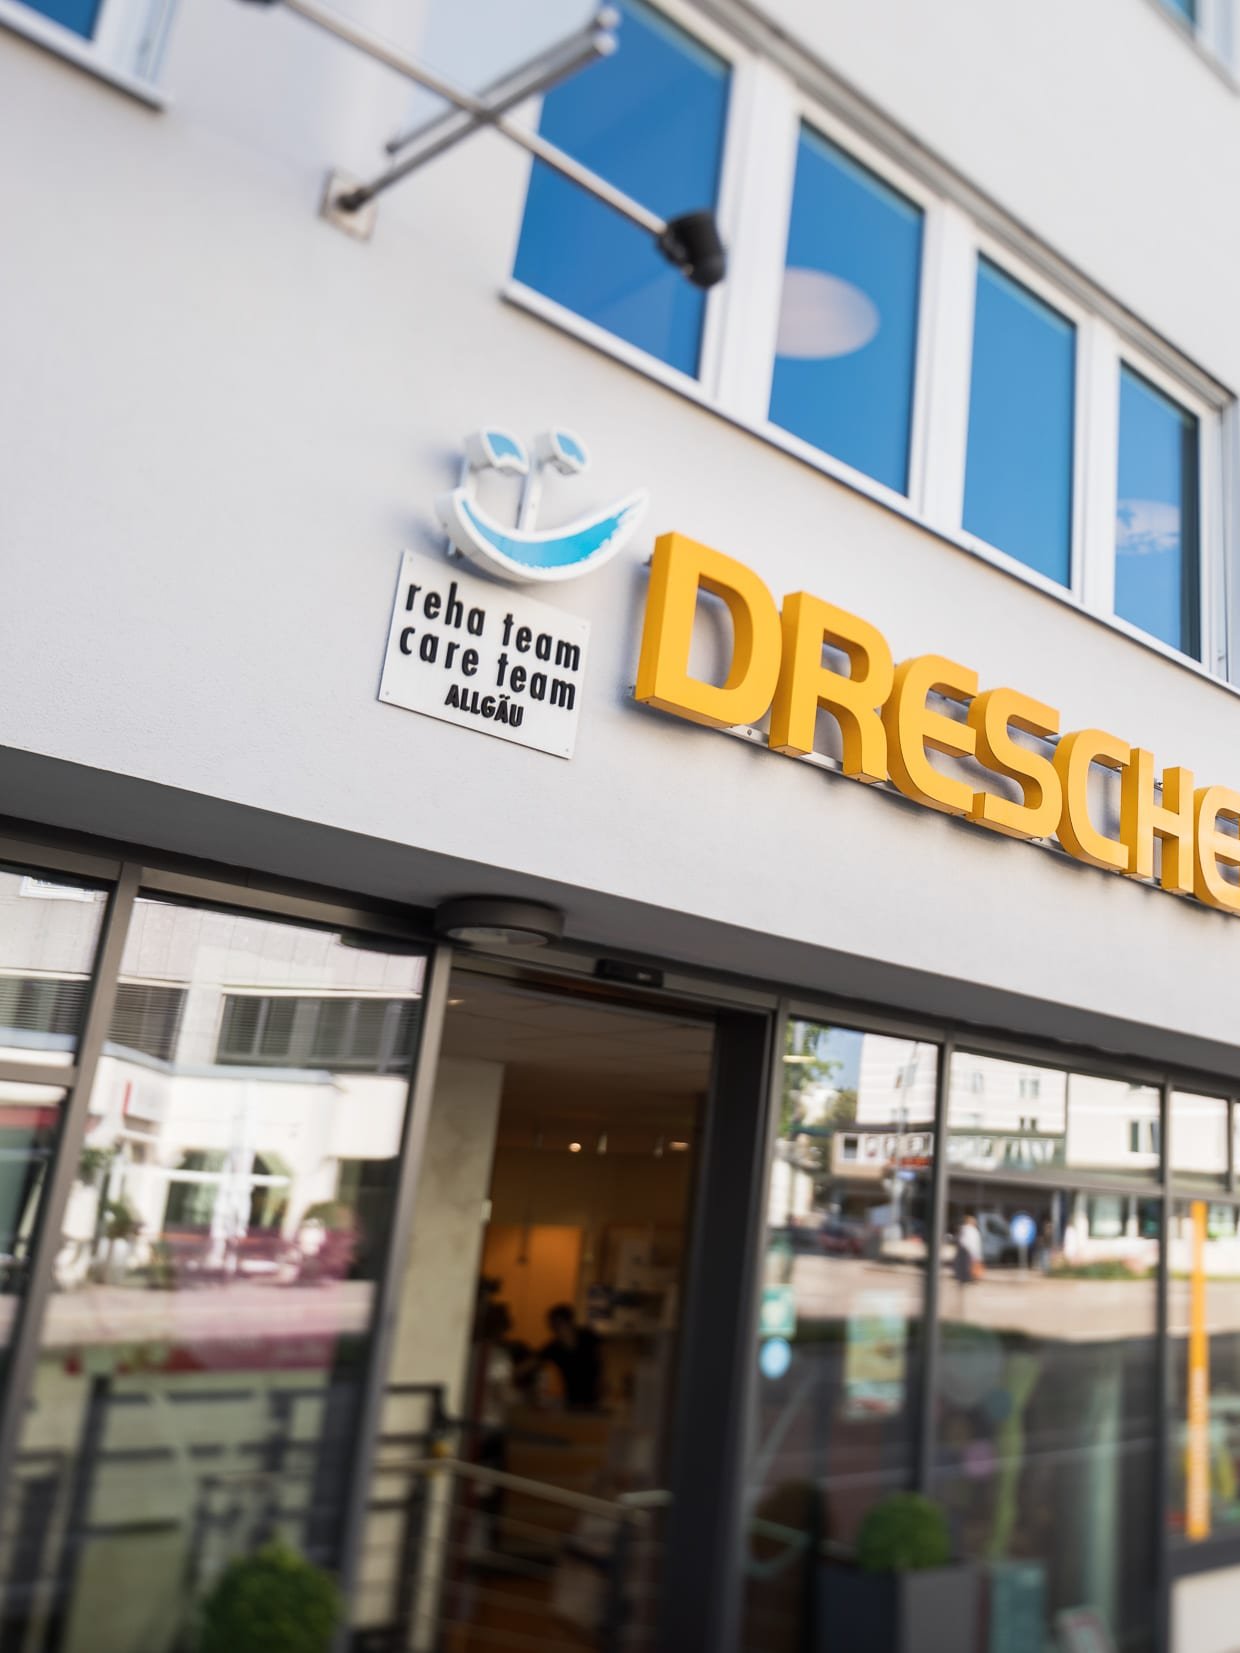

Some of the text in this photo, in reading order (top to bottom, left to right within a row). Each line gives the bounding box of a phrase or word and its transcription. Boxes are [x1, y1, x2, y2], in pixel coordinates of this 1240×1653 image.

[400, 626, 576, 710] care team
[405, 581, 581, 671] reha team
[445, 684, 524, 728] ALLGÄU
